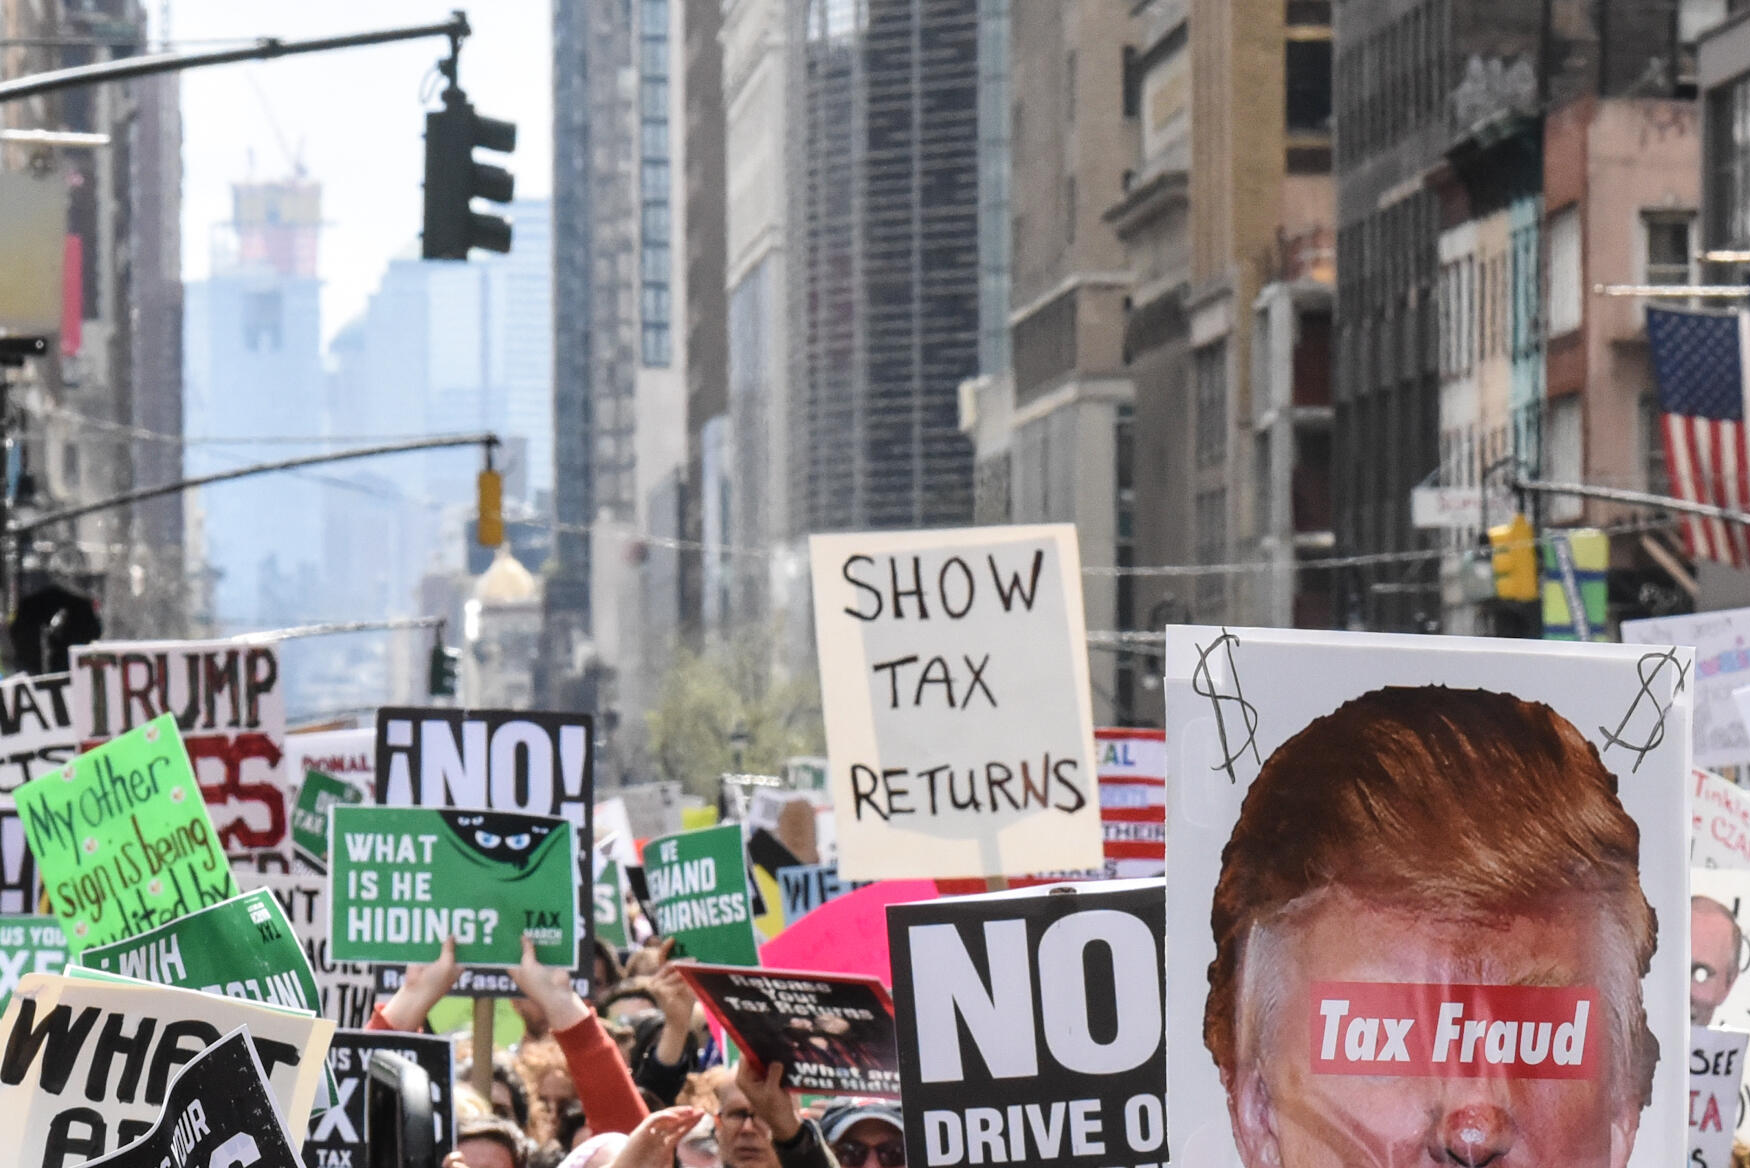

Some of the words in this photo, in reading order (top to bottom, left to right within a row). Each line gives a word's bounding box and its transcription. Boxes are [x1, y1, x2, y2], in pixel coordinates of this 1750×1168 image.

[843, 550, 1044, 622] SHOW
[78, 648, 278, 738] TRUMP
[873, 653, 997, 710] TAX
[28, 792, 82, 866] My
[80, 755, 170, 829] other
[851, 753, 1087, 822] RETURNS
[57, 862, 116, 923] sign
[108, 840, 142, 889] is
[131, 814, 217, 877] being
[345, 832, 438, 864] WHAT
[349, 870, 378, 901] IS
[391, 871, 432, 901] HE
[650, 857, 717, 902] EMAND
[30, 927, 68, 947] YOU
[348, 906, 499, 945] HIDING?
[523, 909, 562, 929] TAX
[1319, 999, 1416, 1065] Tax
[1432, 999, 1592, 1068] Fraud
[317, 1149, 352, 1167] TAX
[923, 1097, 1106, 1168] DRIVE
